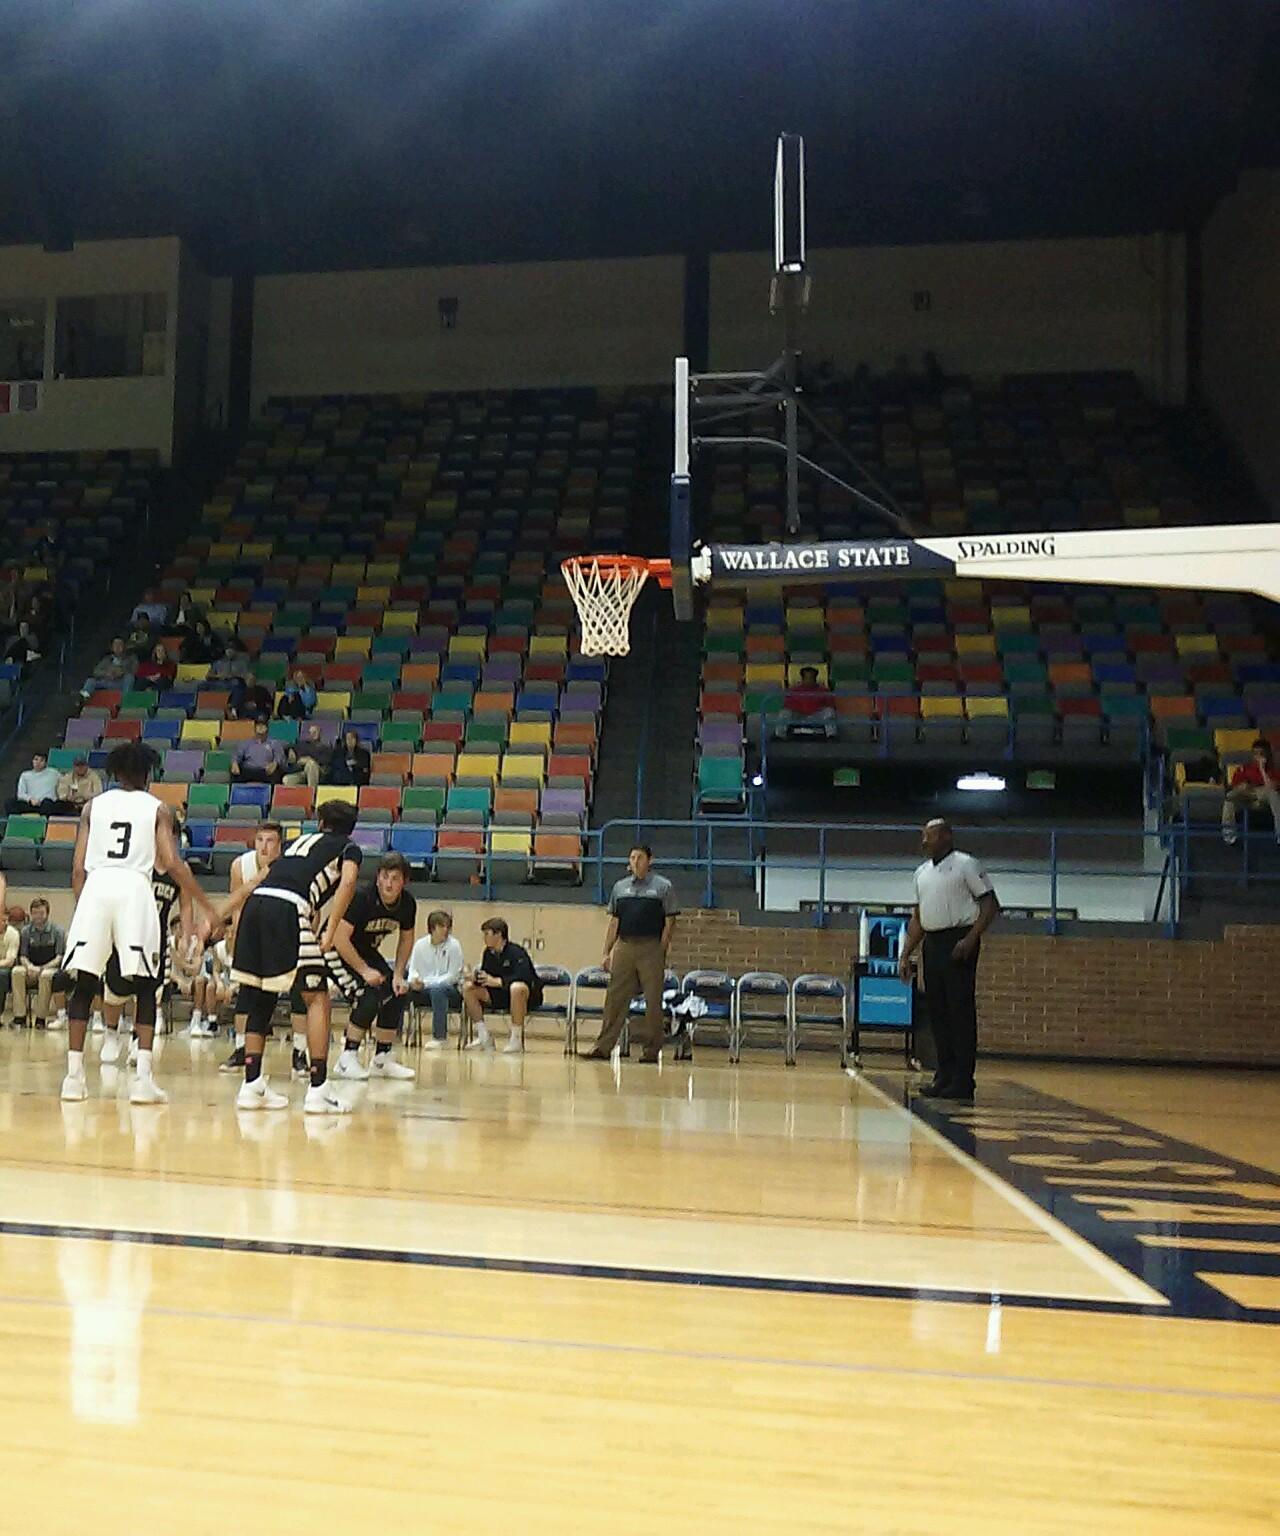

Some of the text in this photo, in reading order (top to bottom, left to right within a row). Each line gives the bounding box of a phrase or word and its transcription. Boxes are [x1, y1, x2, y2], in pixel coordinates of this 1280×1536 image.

[720, 545, 910, 570] WALLACE STATE
[957, 537, 1056, 560] SPALDING
[107, 821, 132, 859] 3
[284, 832, 325, 857] 11
